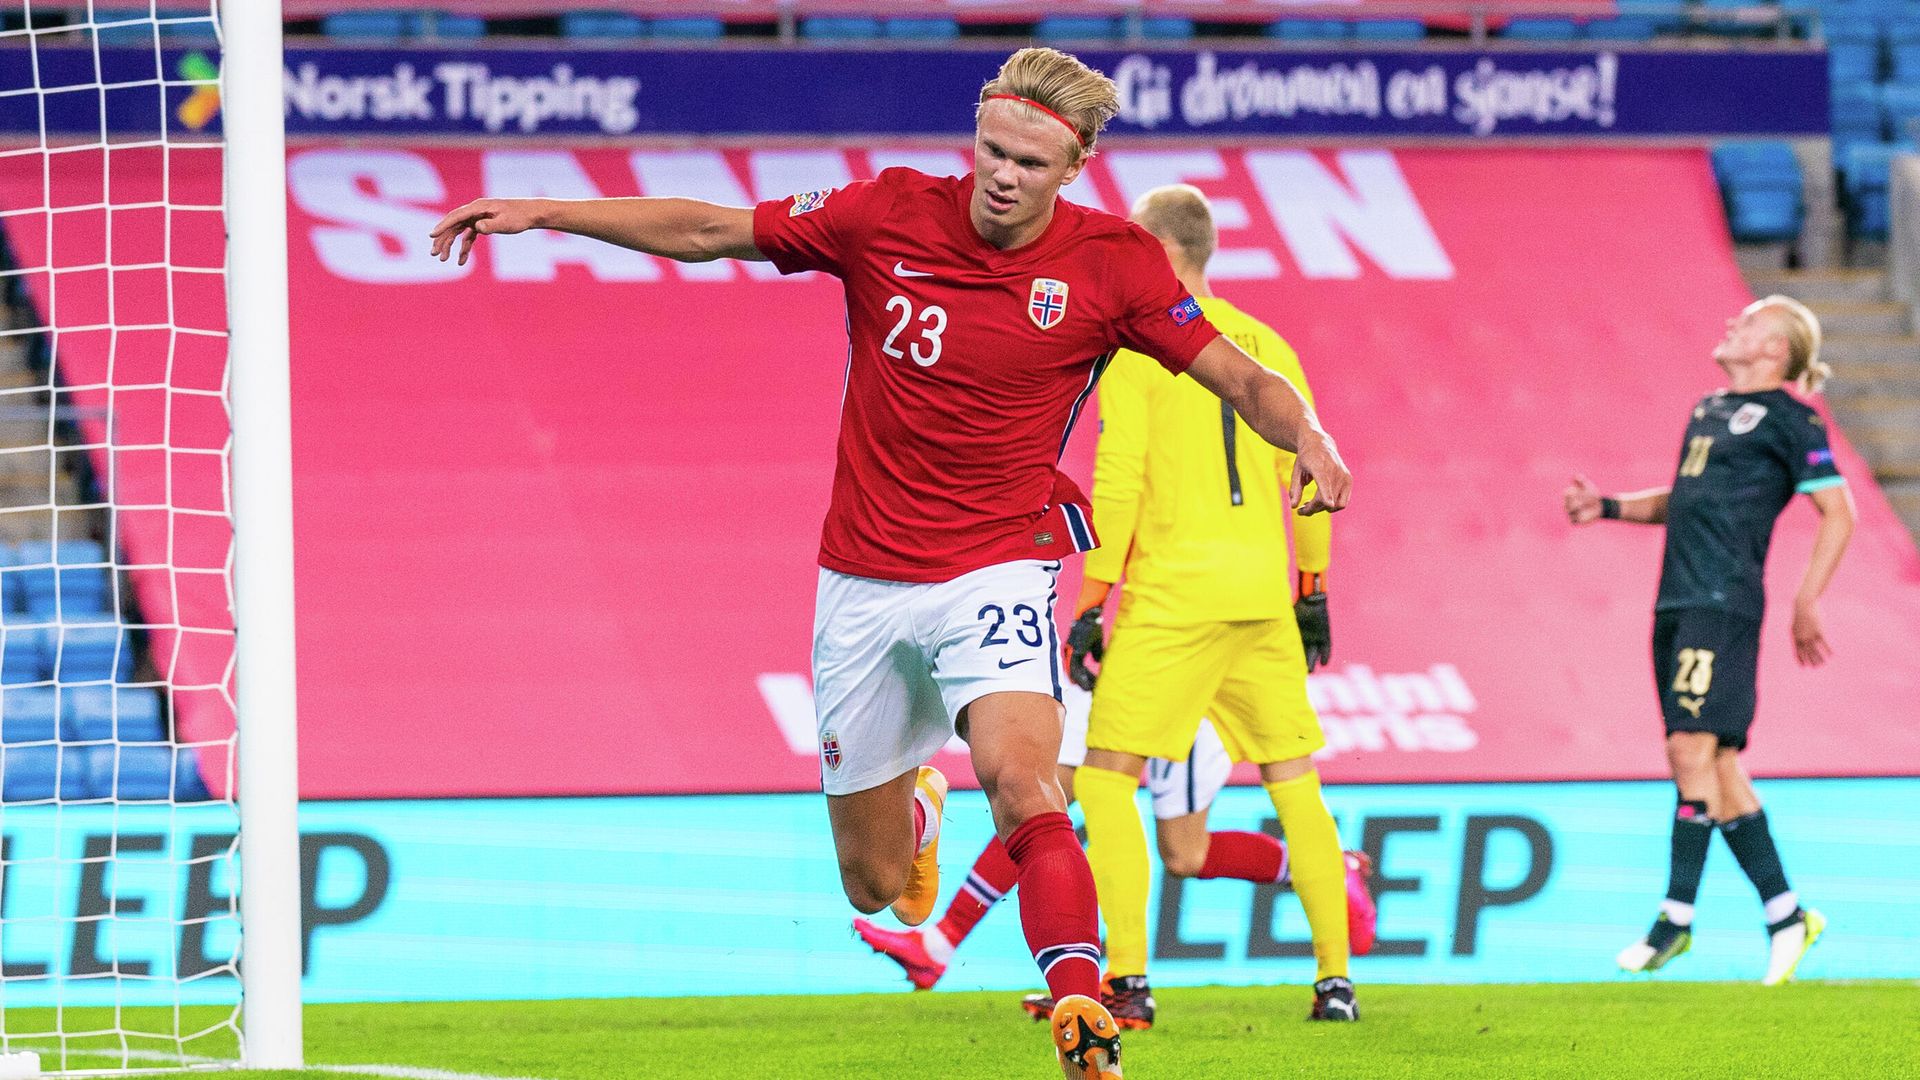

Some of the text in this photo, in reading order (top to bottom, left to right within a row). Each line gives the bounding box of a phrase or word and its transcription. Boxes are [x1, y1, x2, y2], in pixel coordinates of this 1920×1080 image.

[284, 62, 640, 132] Norsk Tipping
[287, 149, 1456, 283] SAMEN
[881, 294, 949, 368] 23
[977, 603, 1043, 648] 23
[1672, 647, 1715, 695] 23
